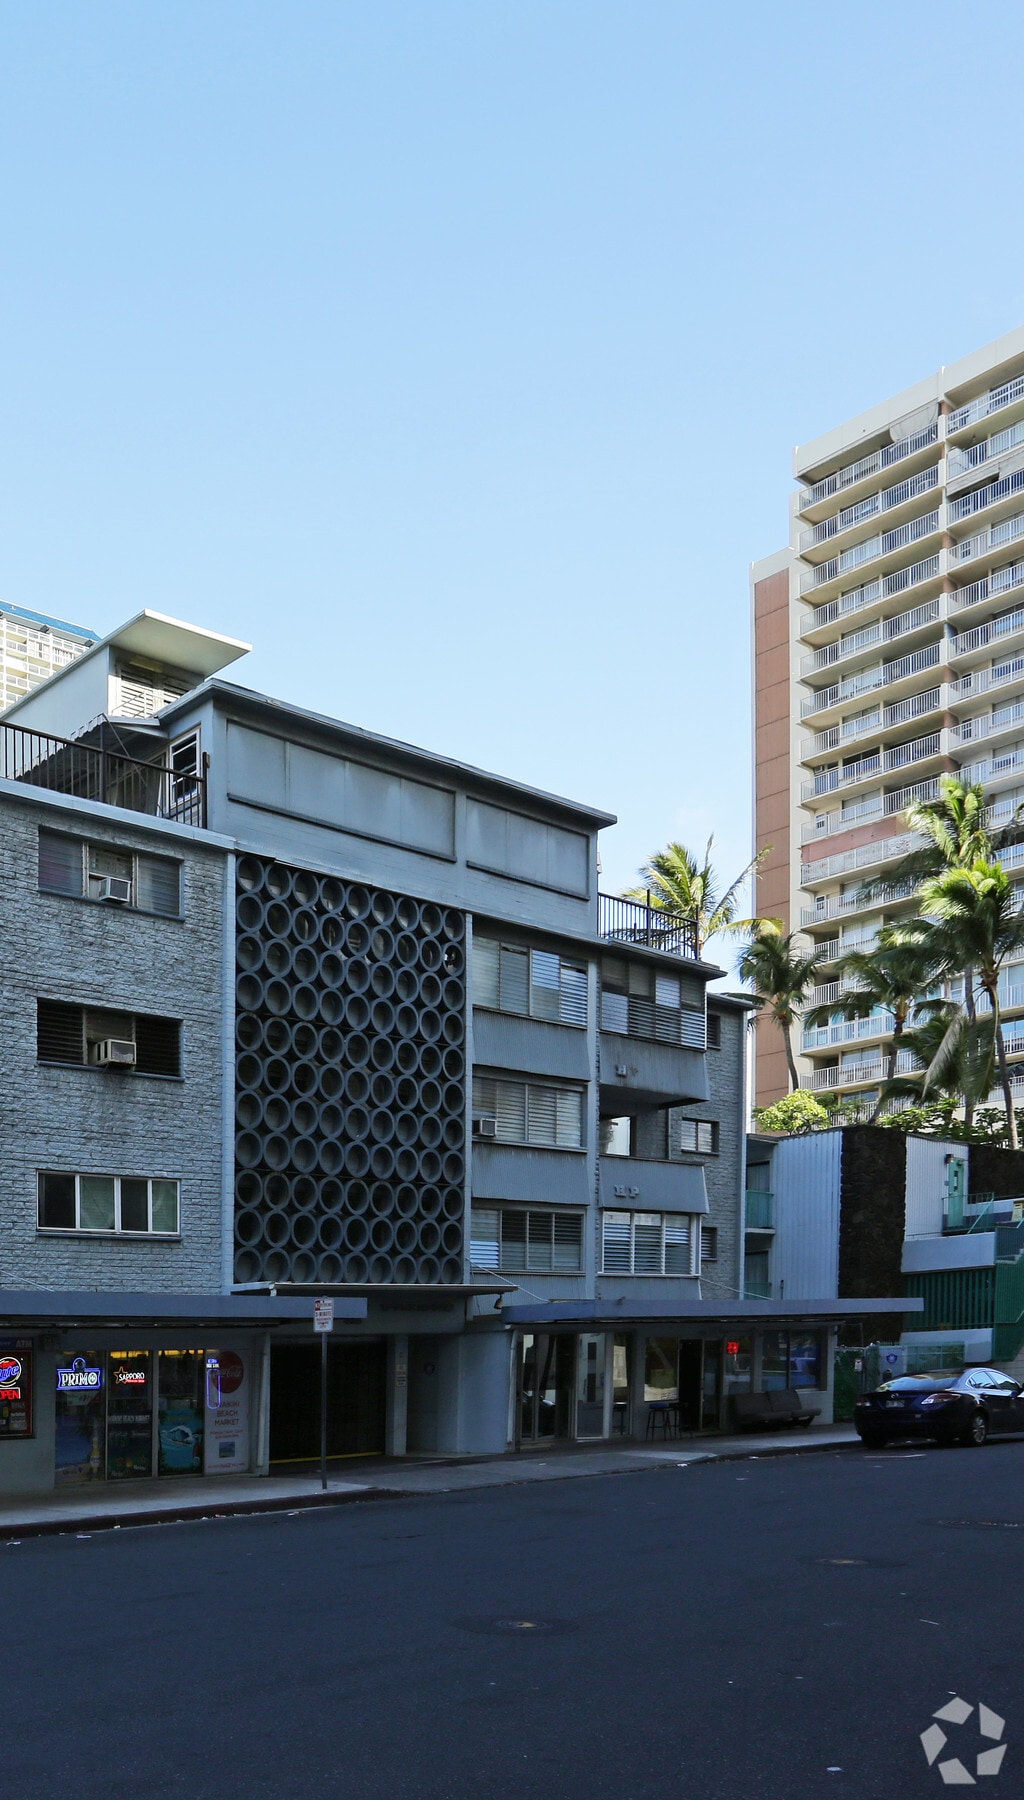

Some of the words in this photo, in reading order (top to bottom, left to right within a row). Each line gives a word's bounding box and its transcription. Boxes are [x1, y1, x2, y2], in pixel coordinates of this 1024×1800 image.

[15, 1339, 33, 1349] ATM
[61, 1372, 98, 1387] PRIMO
[118, 1371, 145, 1382] SAPPORO
[216, 1410, 239, 1418] BEACH
[214, 1418, 241, 1426] MARKET
